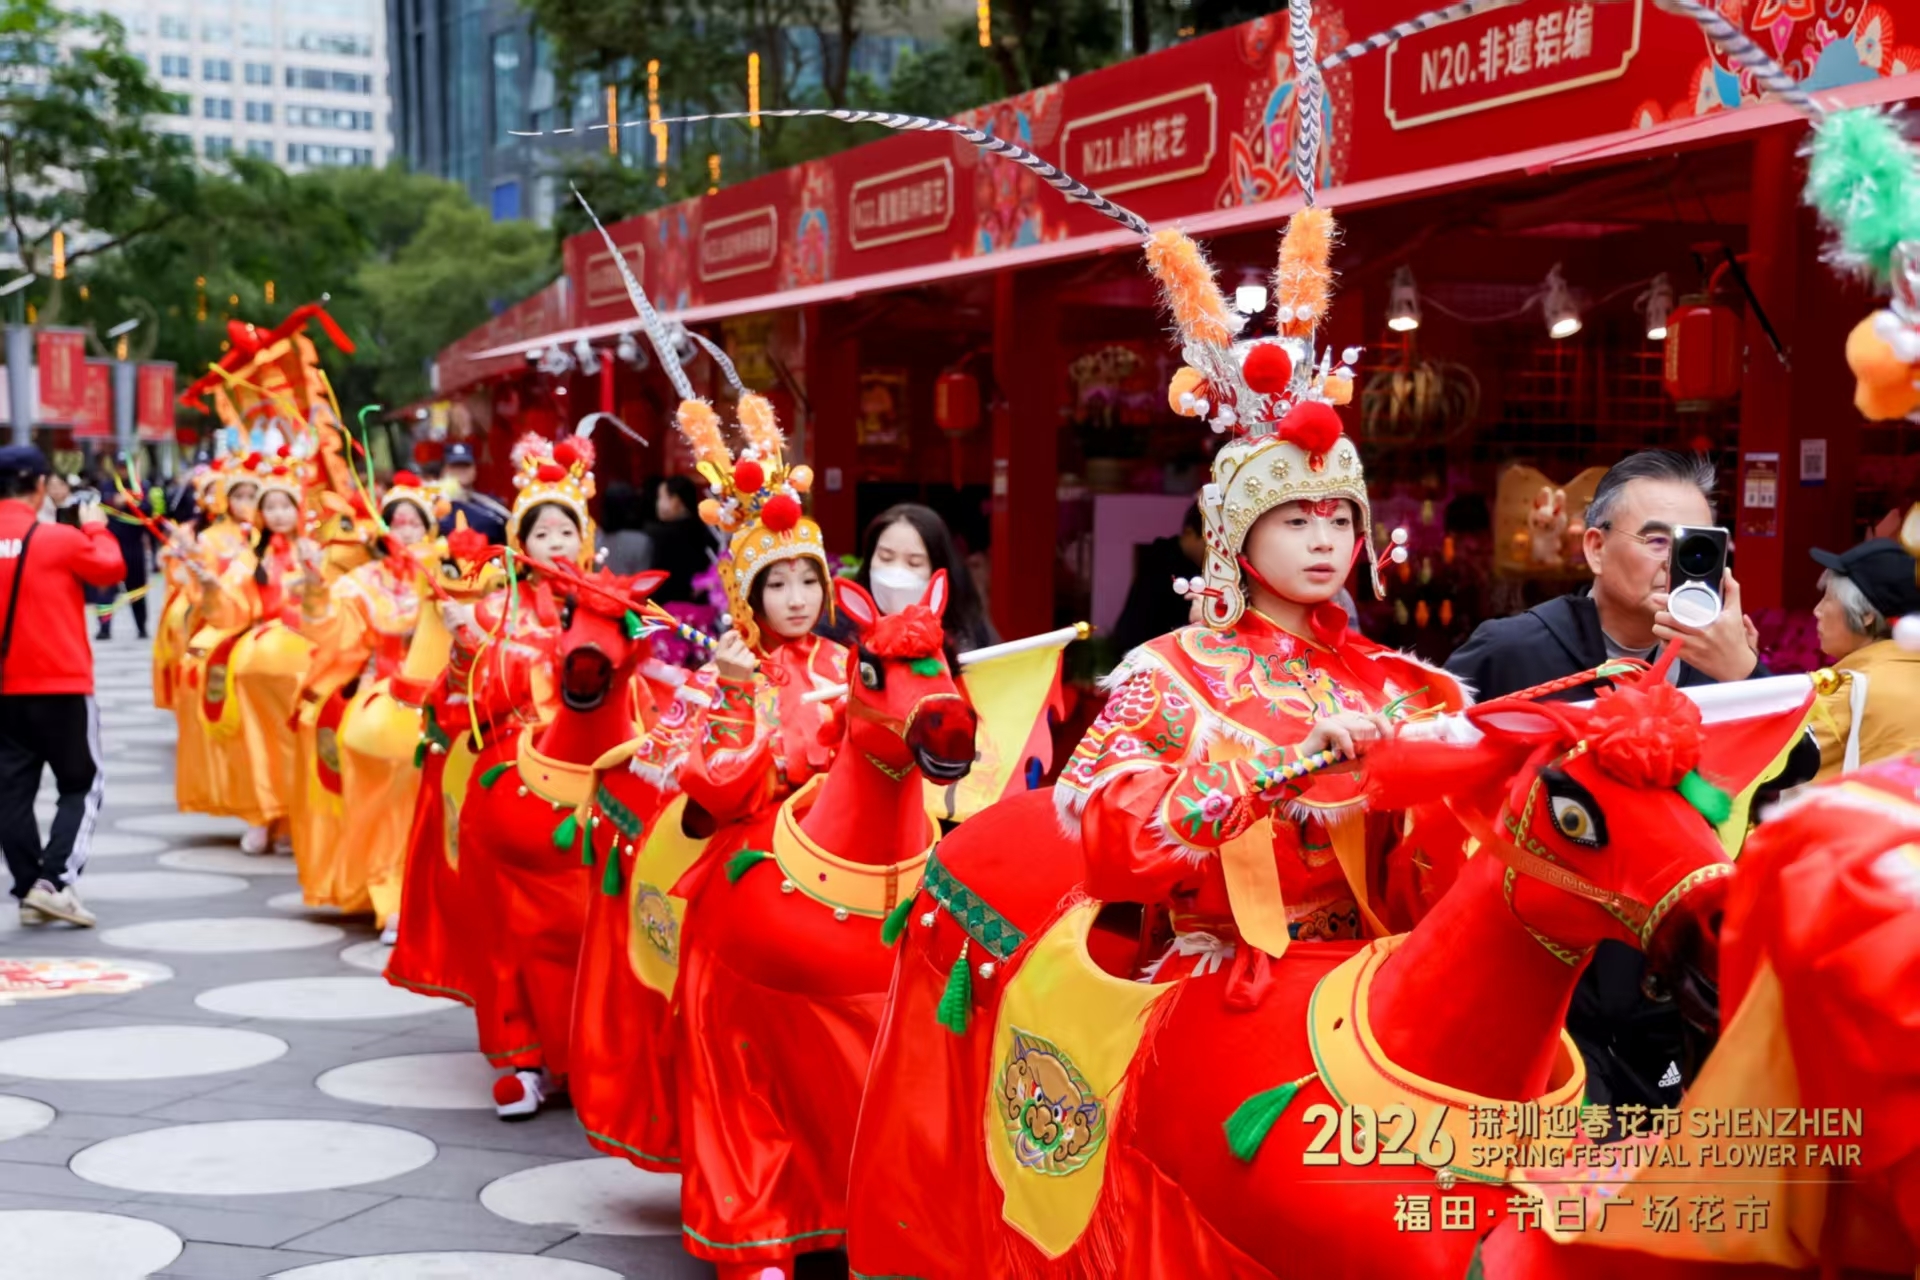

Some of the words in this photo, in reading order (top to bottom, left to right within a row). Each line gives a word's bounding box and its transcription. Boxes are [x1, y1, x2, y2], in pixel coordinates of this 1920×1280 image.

[1420, 4, 1594, 94] N20.非遗铝编
[1083, 112, 1188, 176] N21.山林花艺
